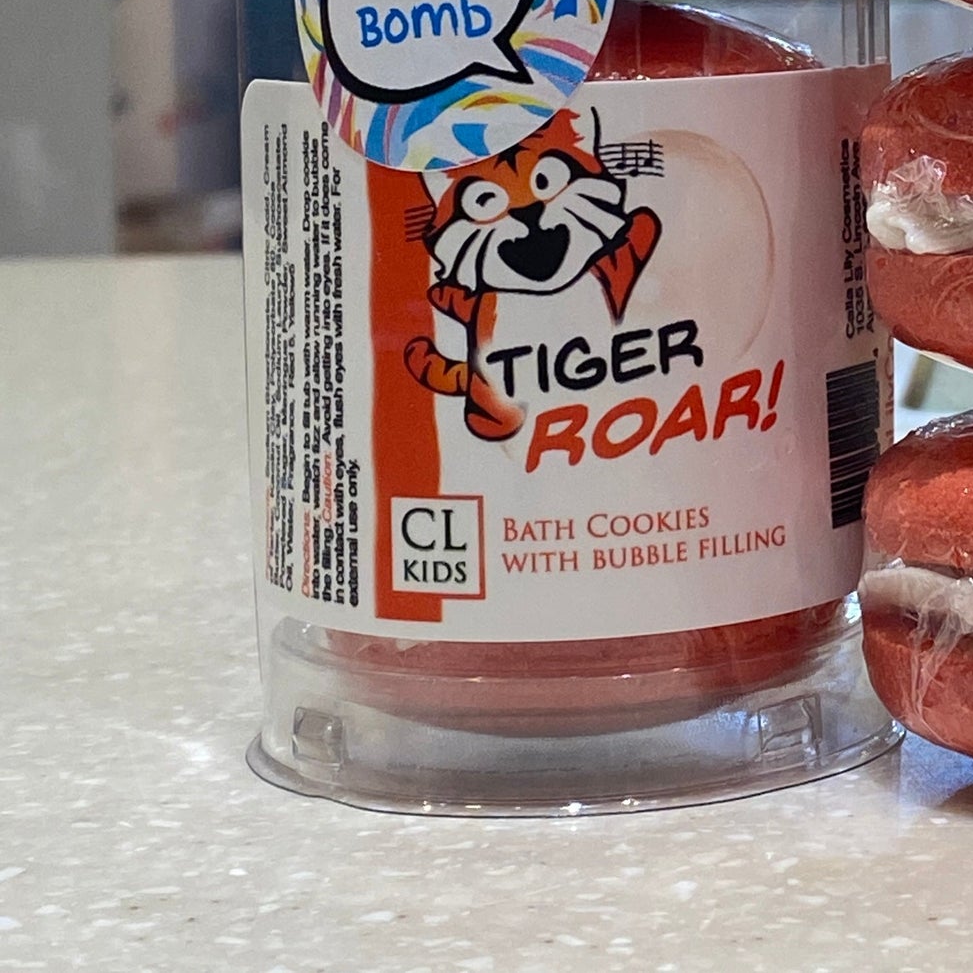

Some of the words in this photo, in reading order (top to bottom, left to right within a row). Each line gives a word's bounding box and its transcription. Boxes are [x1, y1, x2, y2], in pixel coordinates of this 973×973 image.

[321, 121, 329, 169] come
[311, 138, 319, 196] bubble
[331, 167, 340, 196] For
[303, 191, 311, 232] Drop
[312, 200, 319, 216] to
[840, 139, 851, 243] Cosmetics
[321, 233, 330, 245] If
[322, 221, 330, 229] it
[333, 203, 341, 252] water.
[852, 184, 862, 253] Lincoln
[323, 251, 332, 296] eyes.
[332, 256, 342, 299] fresh
[844, 249, 854, 282] Lily
[855, 260, 862, 280] S.
[312, 272, 321, 336] running
[322, 299, 330, 330] into
[333, 304, 342, 337] with
[845, 288, 854, 339] Calla
[312, 341, 320, 384] allow
[322, 335, 333, 392] getting
[334, 342, 345, 384] eyes
[486, 319, 704, 398] TIGER
[322, 396, 331, 445] Avoid
[334, 388, 343, 428] flush
[525, 359, 785, 474] ROAR!
[304, 433, 310, 449] to
[312, 426, 320, 453] fizz
[335, 434, 346, 479] eyes,
[302, 454, 311, 503] Begin
[312, 458, 320, 509] watch
[322, 452, 332, 523] Caution:
[347, 459, 360, 497] only.
[334, 483, 343, 518] with
[348, 501, 357, 533] use
[312, 515, 321, 565] water,
[401, 507, 467, 552] CL
[503, 518, 575, 542] BATH
[586, 506, 711, 539] COOKIES
[302, 510, 310, 597] Directions:
[335, 522, 344, 585] contact
[502, 550, 580, 573] WITH
[592, 541, 688, 571] BUBBLE
[699, 525, 787, 559] FILLING
[311, 569, 319, 599] into
[322, 575, 331, 602] the
[347, 538, 358, 607] external
[403, 559, 467, 584] KIDS
[335, 589, 344, 604] in
